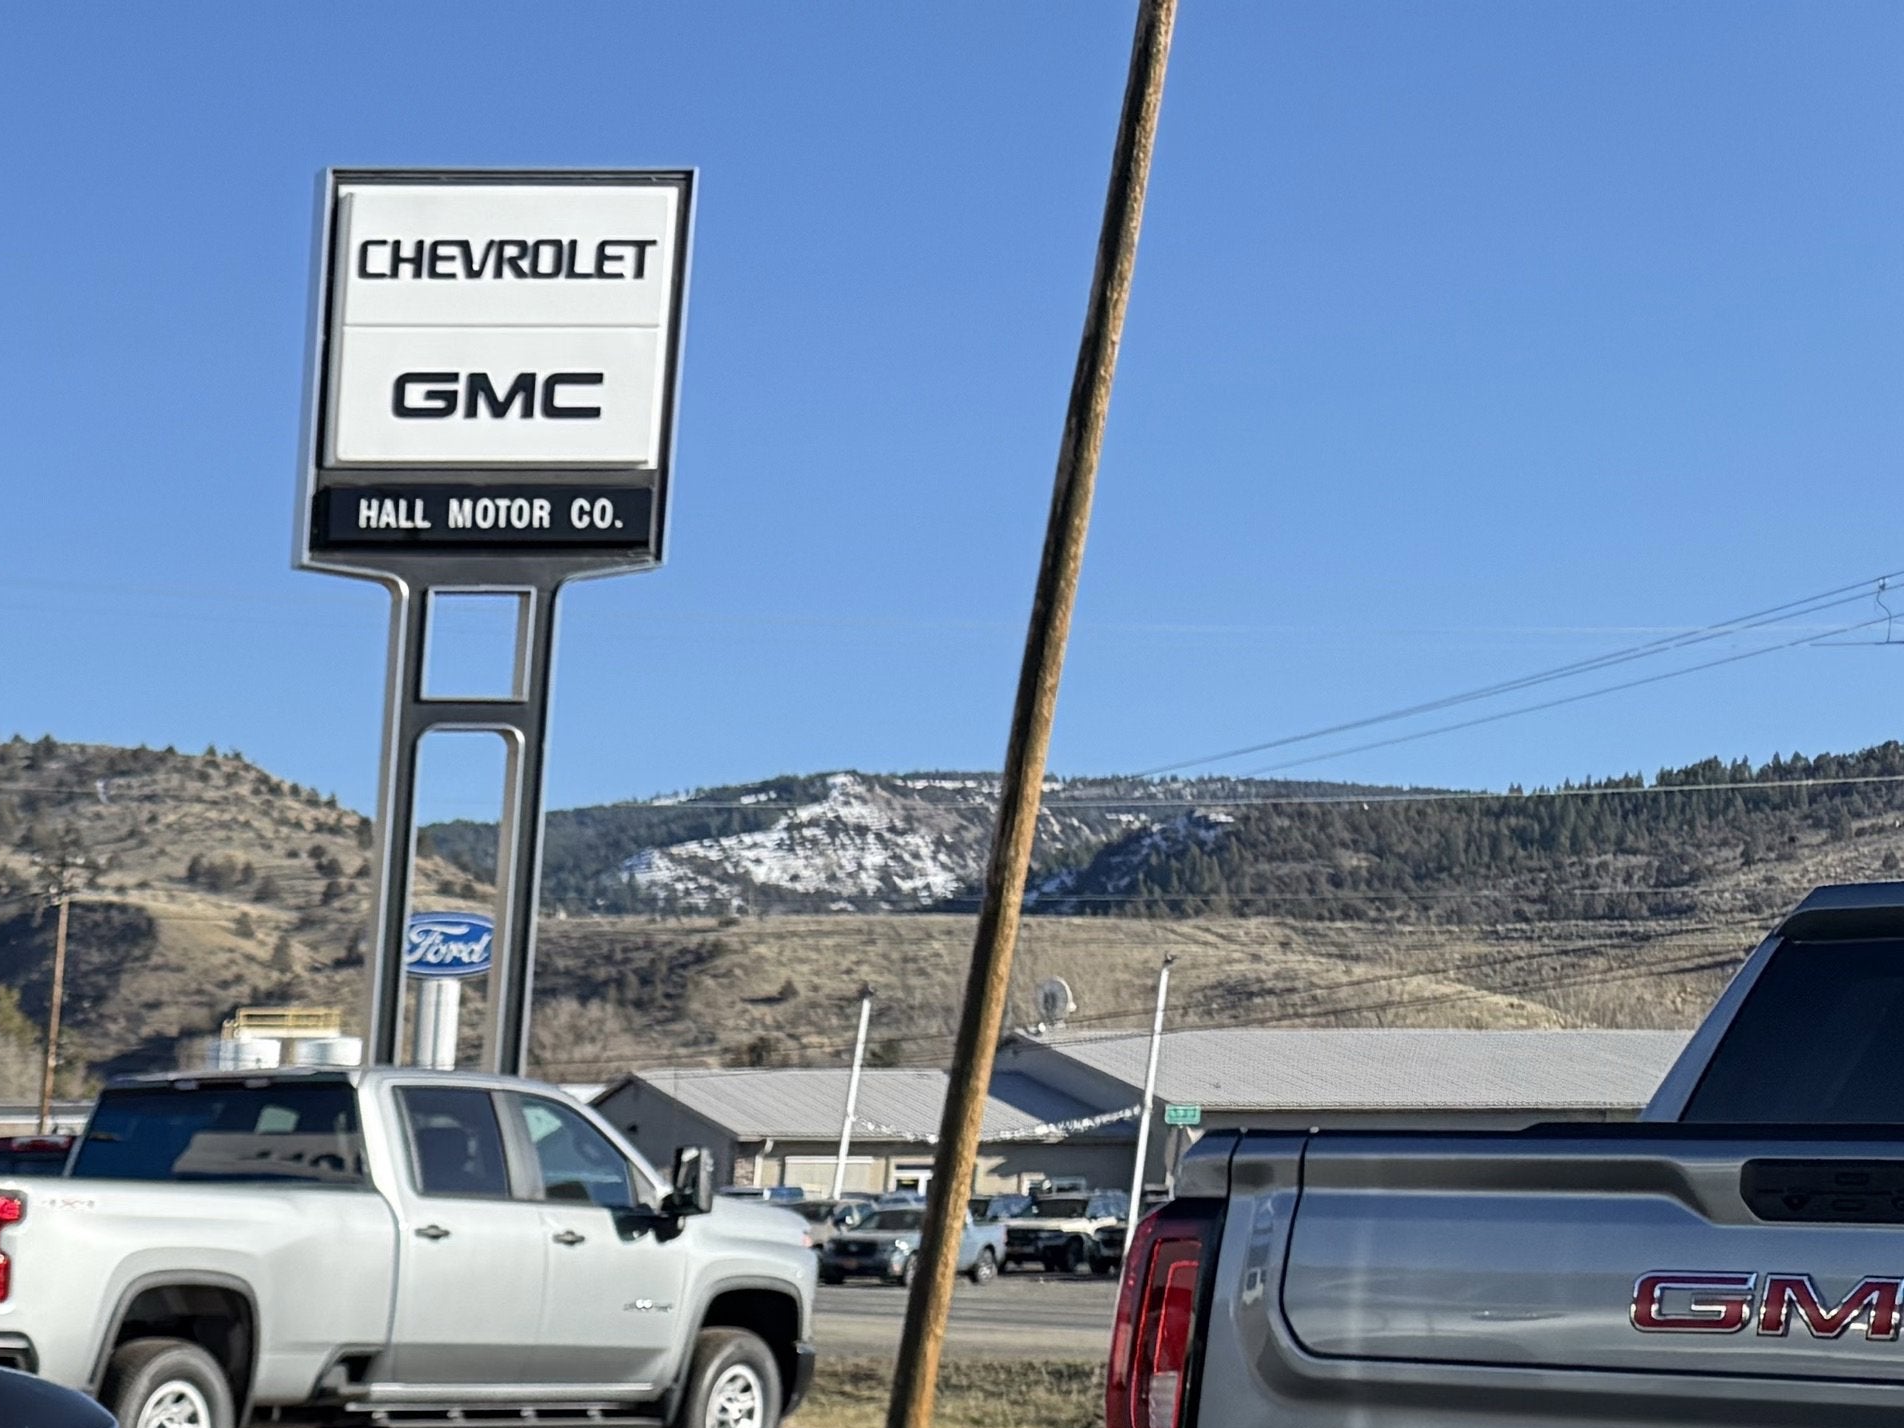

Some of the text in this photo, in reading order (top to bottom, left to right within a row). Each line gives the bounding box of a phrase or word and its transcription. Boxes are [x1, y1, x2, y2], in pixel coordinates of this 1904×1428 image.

[358, 239, 658, 280] CHEVROLET
[392, 371, 604, 420] GMC
[359, 498, 623, 529] HALL MOTOR CO.
[404, 923, 493, 964] Ford
